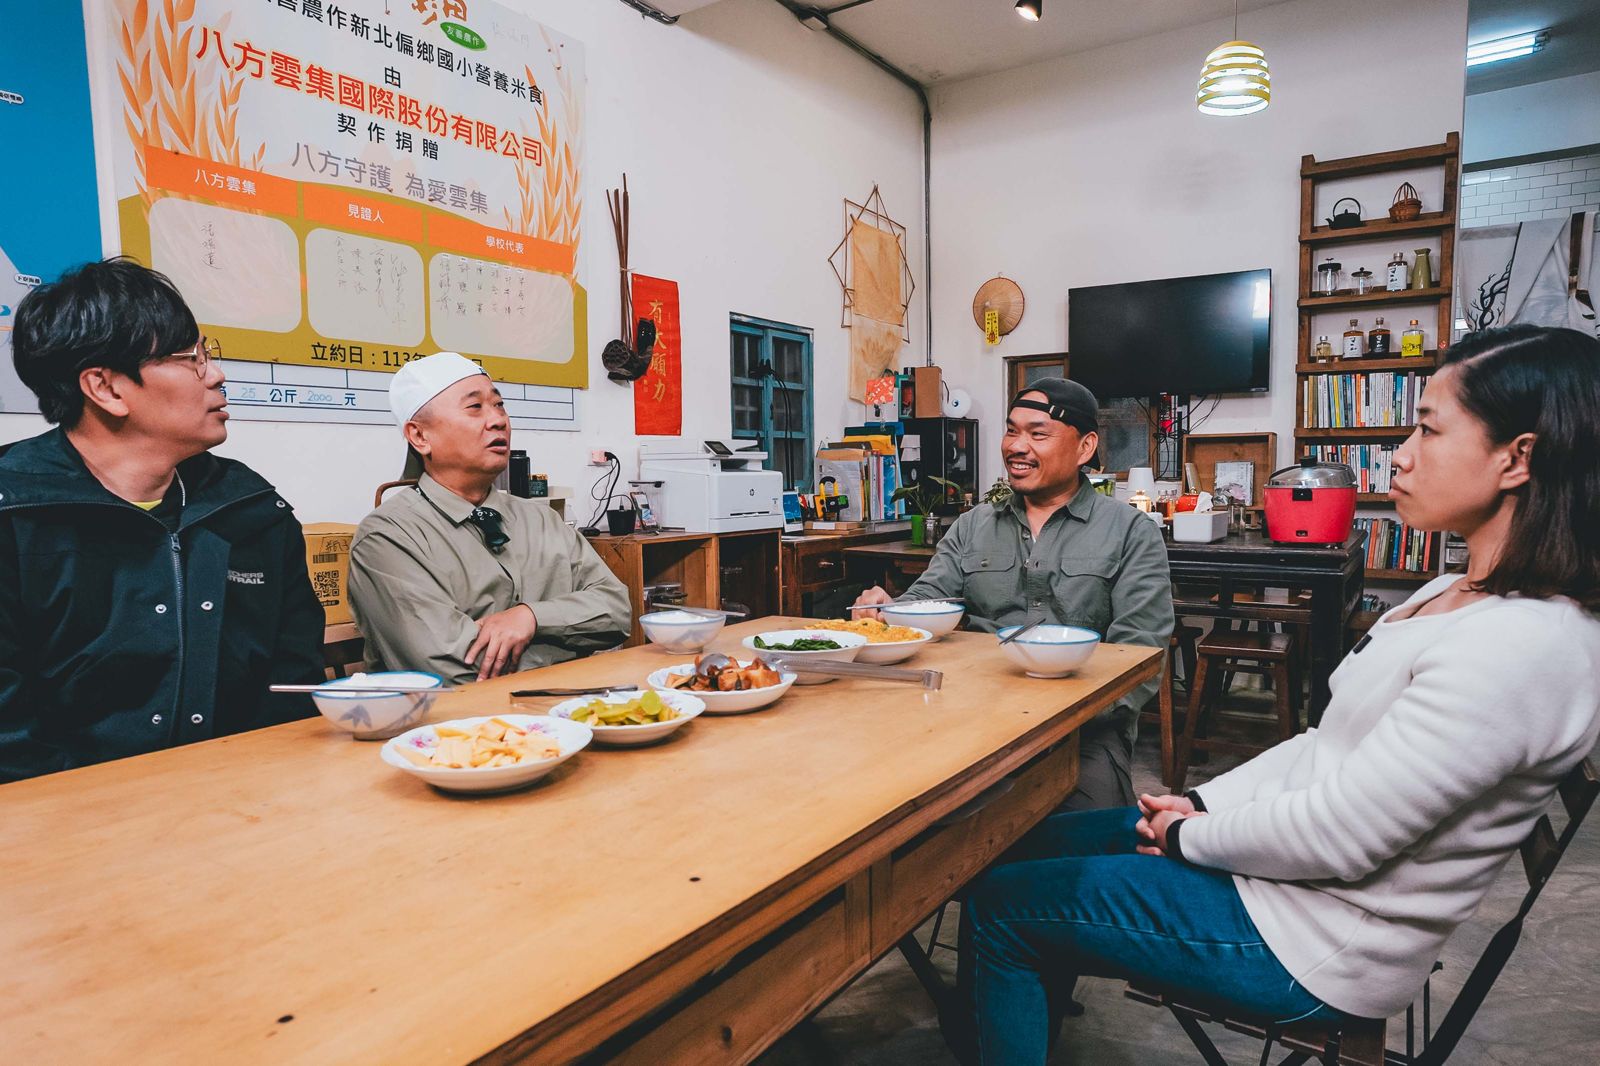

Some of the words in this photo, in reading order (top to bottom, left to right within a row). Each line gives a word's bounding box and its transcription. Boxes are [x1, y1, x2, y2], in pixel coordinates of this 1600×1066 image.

[267, 0, 543, 106] 農作新北偏鄉國小營養米食
[384, 66, 401, 89] 由
[195, 26, 542, 167] 八方雲集國際股份有限公司
[194, 168, 257, 196] 八方雲集
[291, 142, 392, 192] 八方守護
[405, 171, 488, 214] 為愛雲集
[348, 203, 384, 224] 見證人
[486, 235, 524, 254] 學校代表
[241, 387, 256, 399] 25
[269, 388, 297, 403] 公斤
[344, 393, 356, 406] 元
